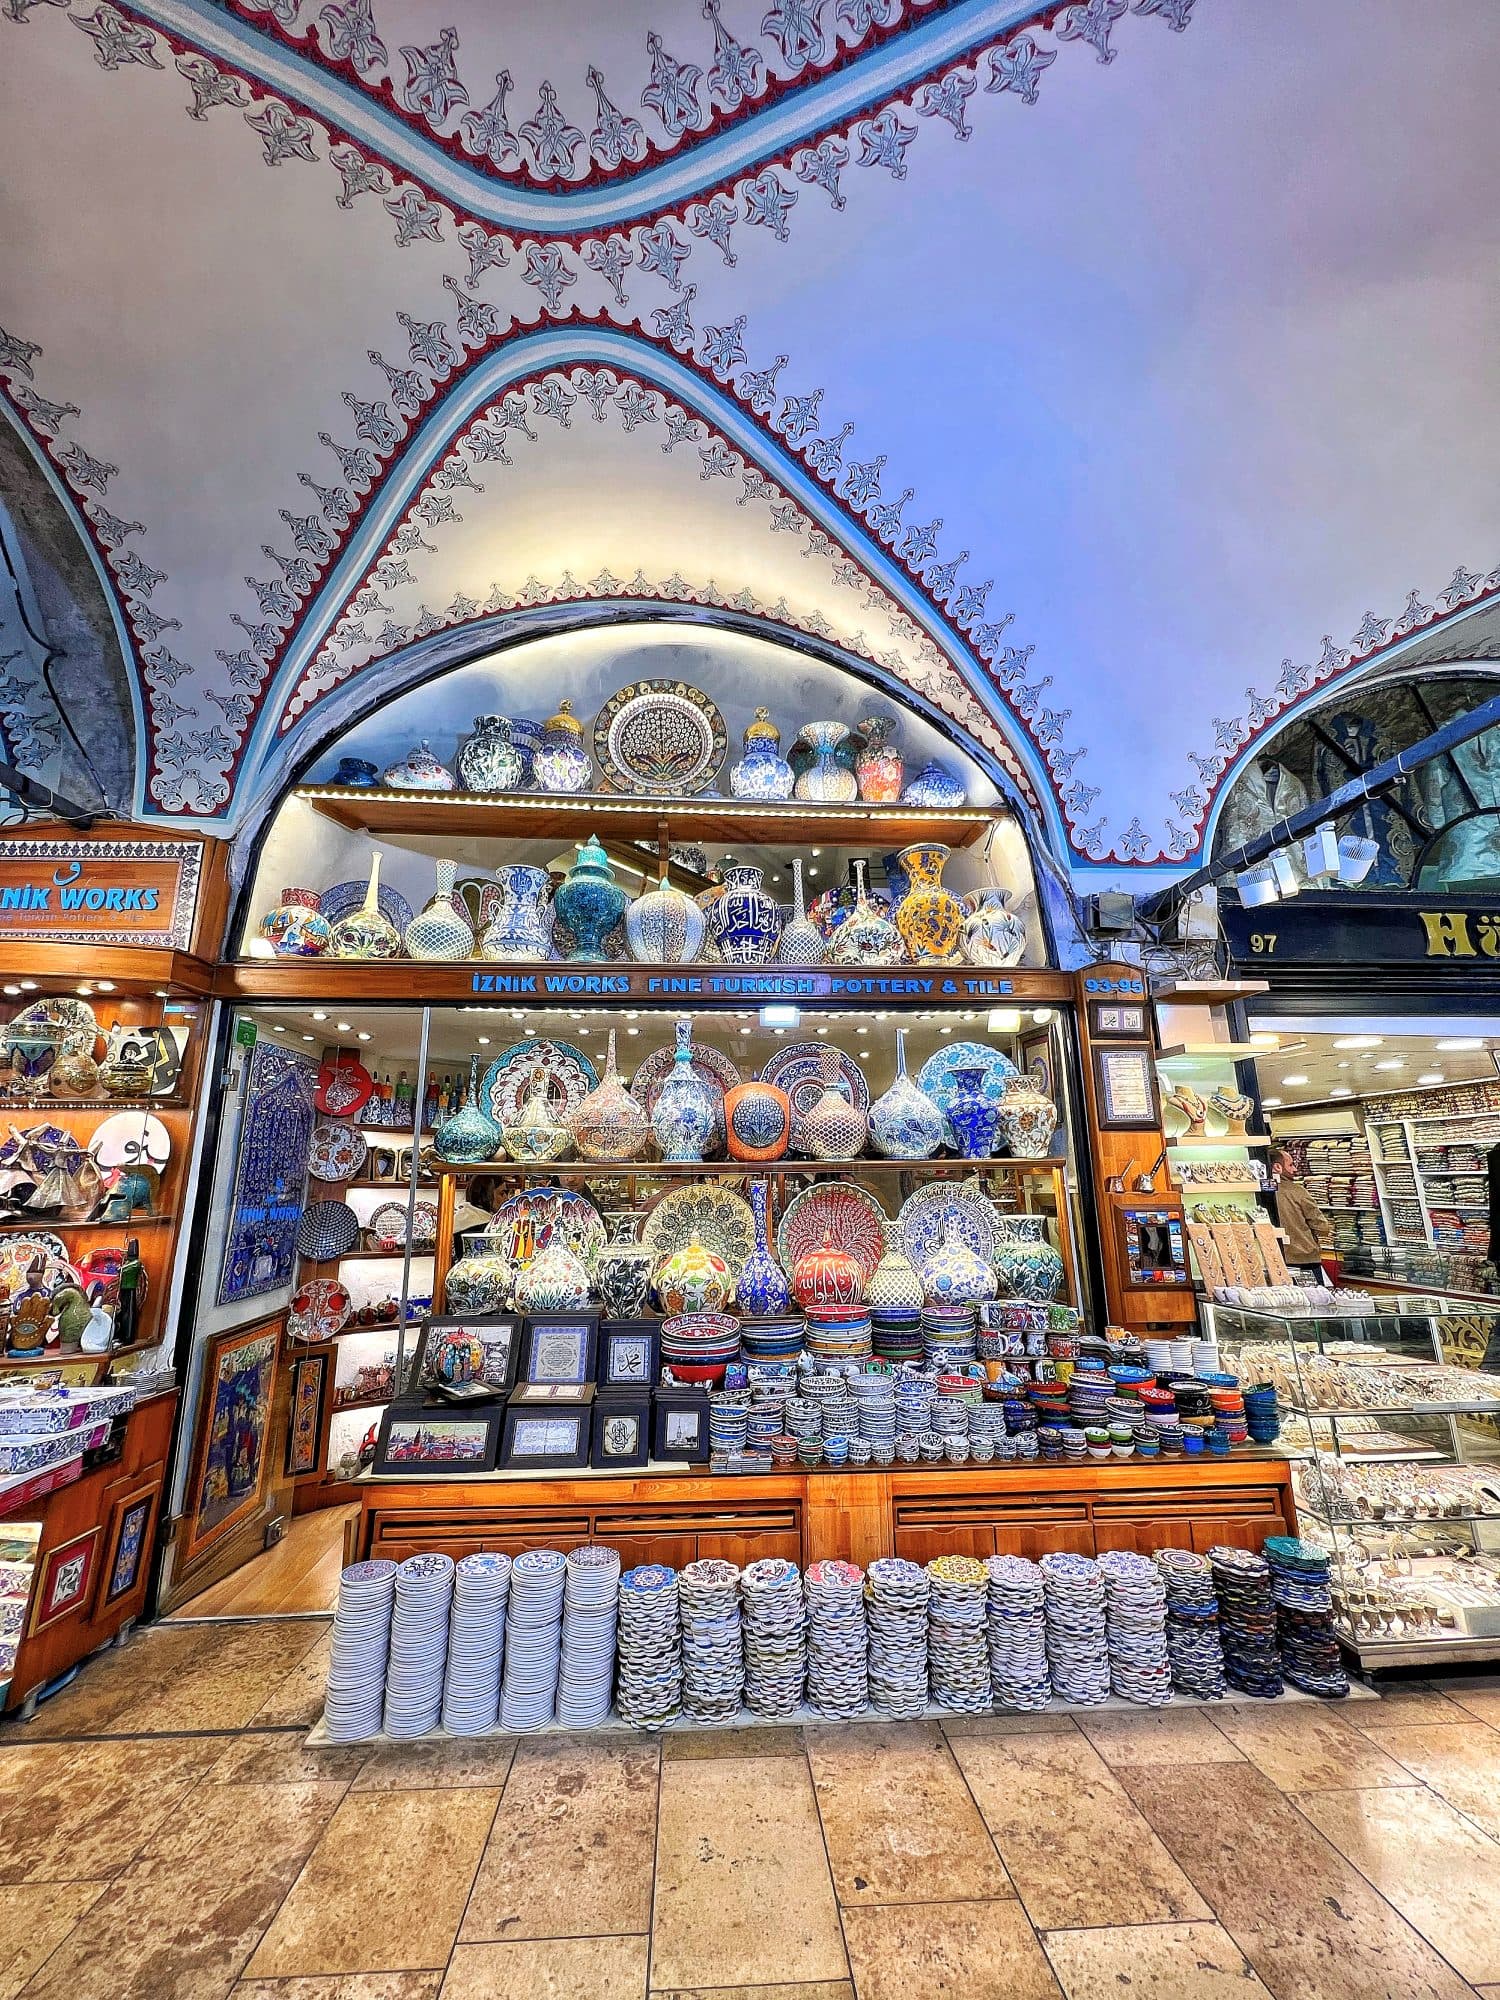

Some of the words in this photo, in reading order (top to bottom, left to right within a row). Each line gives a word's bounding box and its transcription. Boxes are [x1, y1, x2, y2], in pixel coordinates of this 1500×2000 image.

[0, 884, 51, 911] NİK
[60, 888, 159, 912] WORKS
[1250, 934, 1277, 953] 97
[545, 976, 630, 994] WORKS
[648, 978, 702, 993] FINE
[710, 978, 814, 993] TURKISH
[831, 979, 933, 993] POTTERY
[941, 980, 958, 993] &
[964, 980, 1013, 994] TILE
[1085, 978, 1144, 993] 93-95
